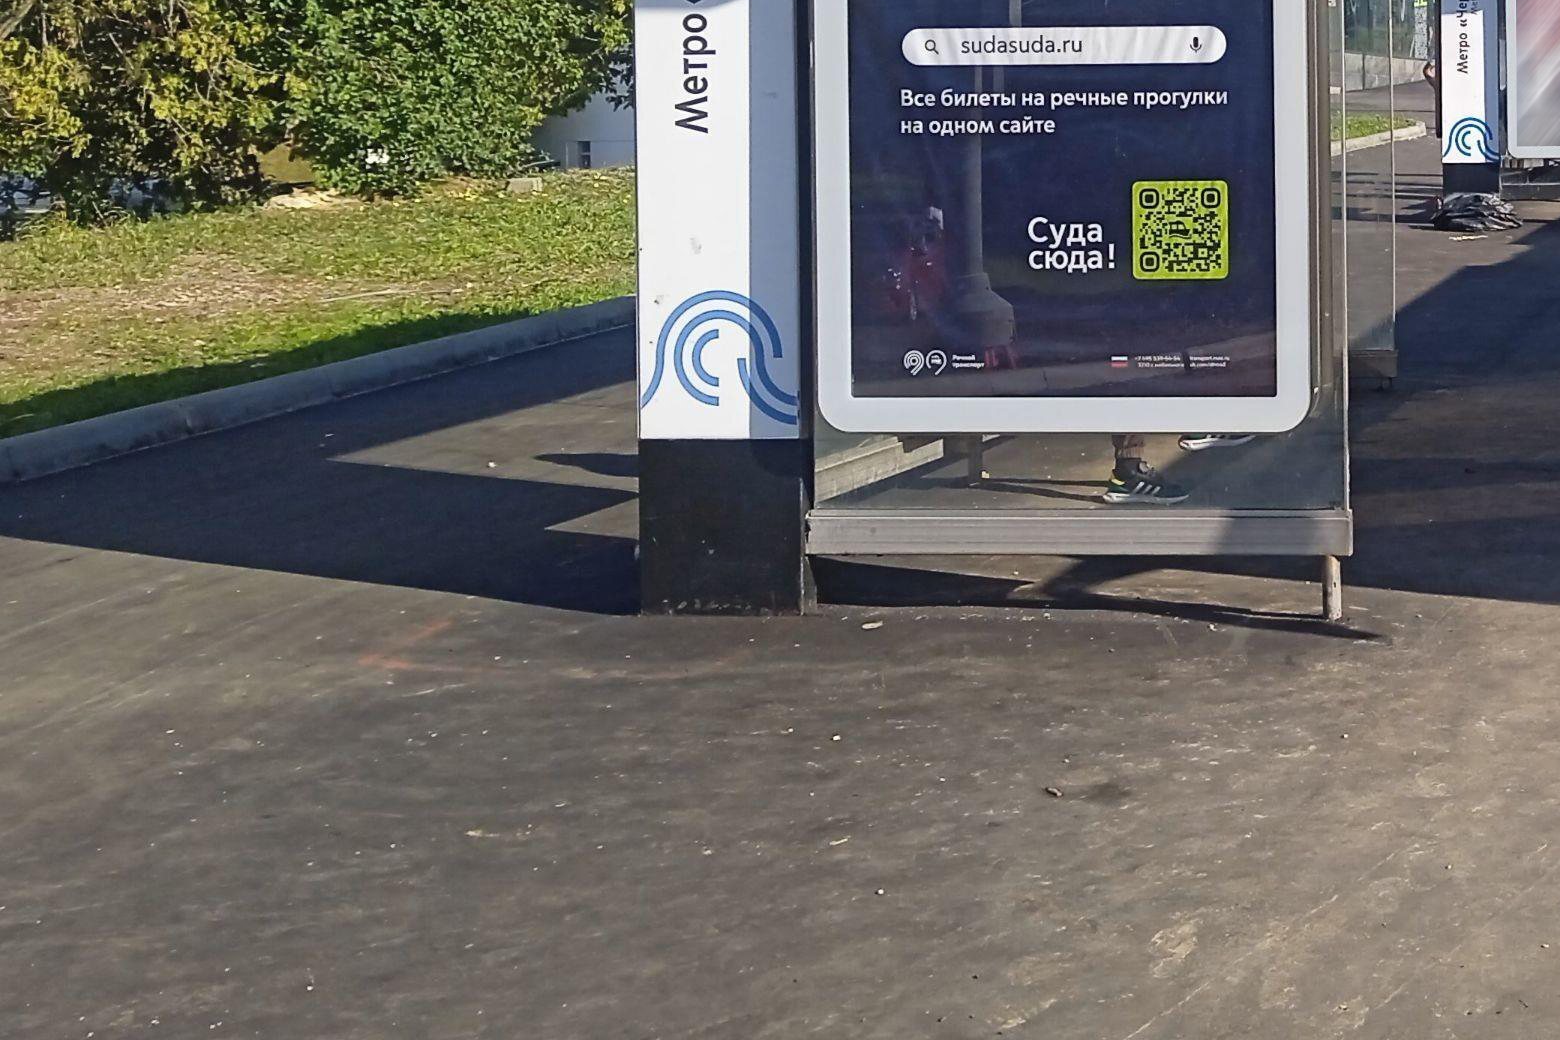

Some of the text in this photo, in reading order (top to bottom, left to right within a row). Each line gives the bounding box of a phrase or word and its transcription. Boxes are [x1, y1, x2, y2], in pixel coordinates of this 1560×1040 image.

[960, 34, 1083, 54] sudasuda.ru
[1456, 32, 1471, 74] Метро
[674, 13, 716, 134] Метро
[901, 88, 1228, 110] Все билеты на речные прогулки
[901, 116, 1056, 136] на одном сайте
[1027, 216, 1103, 249] Суда
[1028, 243, 1116, 274] сюда!
